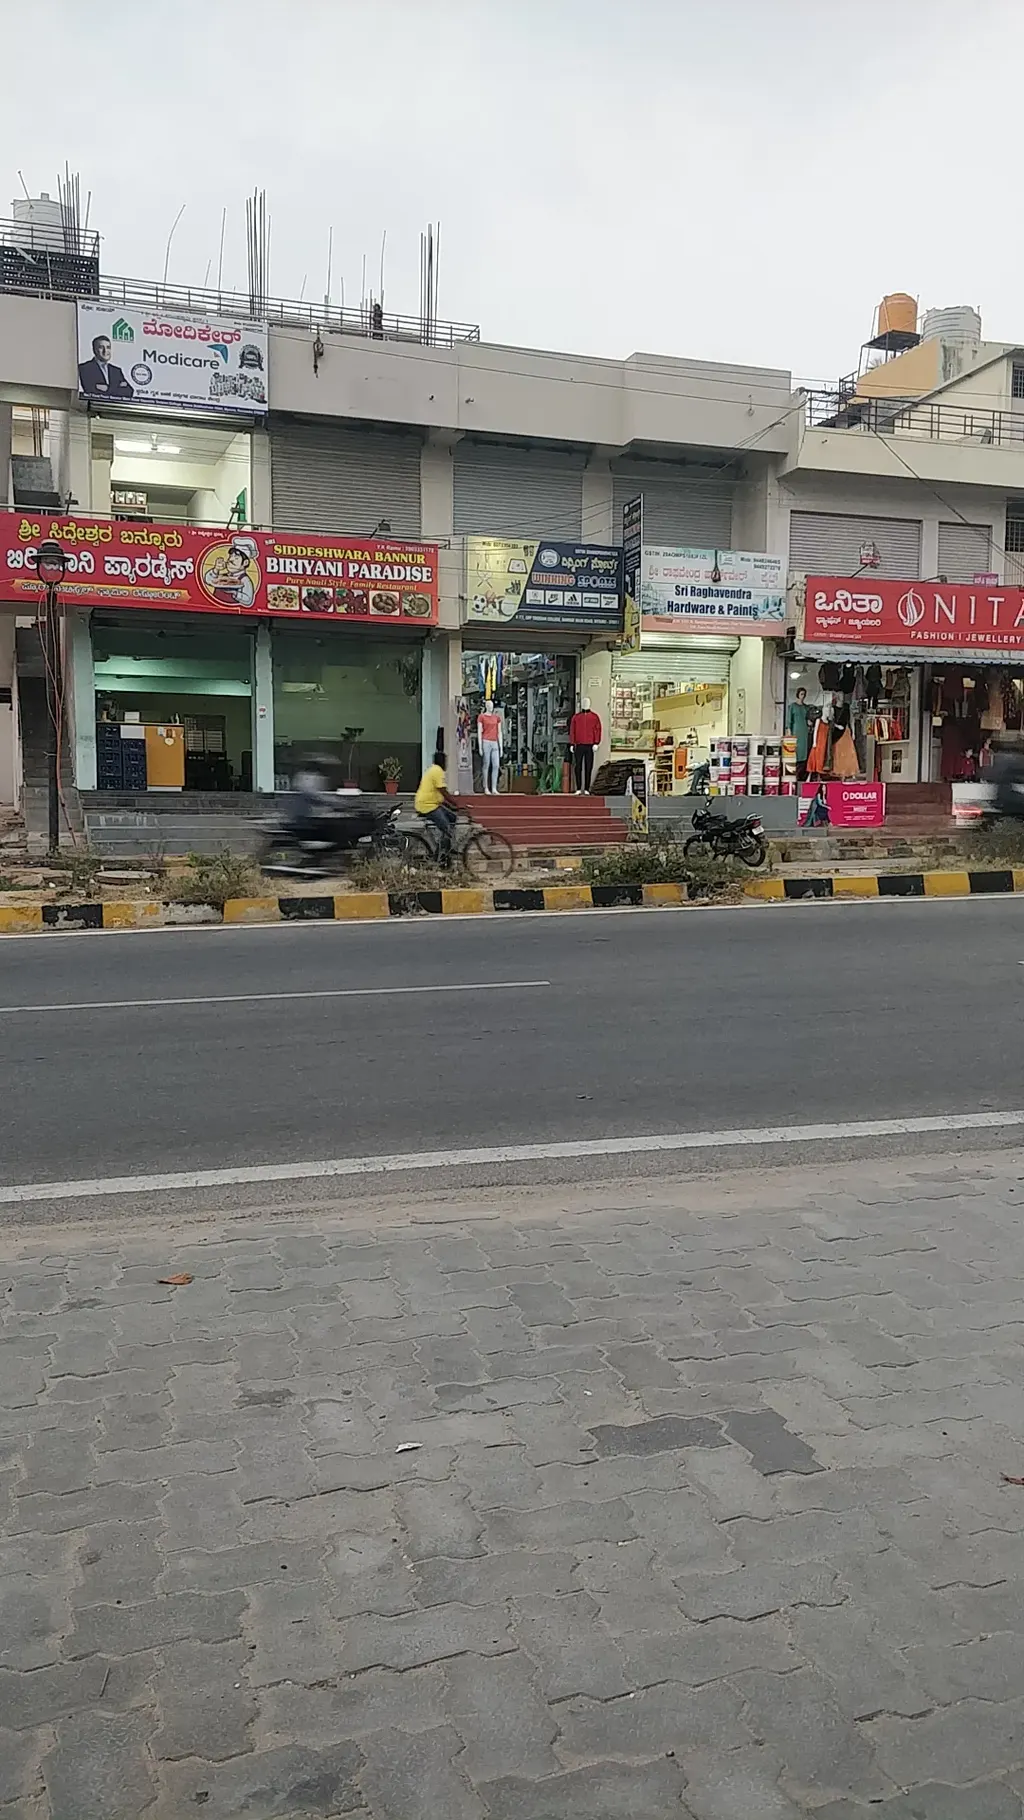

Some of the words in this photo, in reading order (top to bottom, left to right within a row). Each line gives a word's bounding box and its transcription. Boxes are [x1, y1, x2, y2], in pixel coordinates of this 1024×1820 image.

[142, 318, 242, 345] ಮೋದಿಕೇರ್
[142, 348, 220, 370] Modicare
[18, 519, 41, 541] ಶ್ರೀ
[120, 526, 183, 551] ಬನ್ನೂರು
[273, 544, 371, 561] SIDDESHWARA
[375, 552, 426, 565] BANNUR
[104, 552, 195, 585] ಪ್ಯಾರಡೈಸ್
[266, 557, 343, 577] BIRIYANI
[348, 562, 433, 583] PARADISE
[328, 579, 346, 588] Style
[349, 580, 375, 589] Family
[376, 582, 417, 591] Restaurant
[531, 571, 576, 586] WINNING
[577, 575, 617, 589] SPORTS
[674, 584, 688, 597] Sri
[690, 585, 752, 600] Raghavendra
[814, 589, 883, 613] ಒನಿತಾ
[667, 600, 716, 615] Hardware
[718, 605, 725, 615] &
[727, 603, 759, 618] Paints
[910, 630, 954, 641] FASHION
[965, 634, 1022, 644] JEWELLERY
[849, 792, 877, 800] DOLLAR
